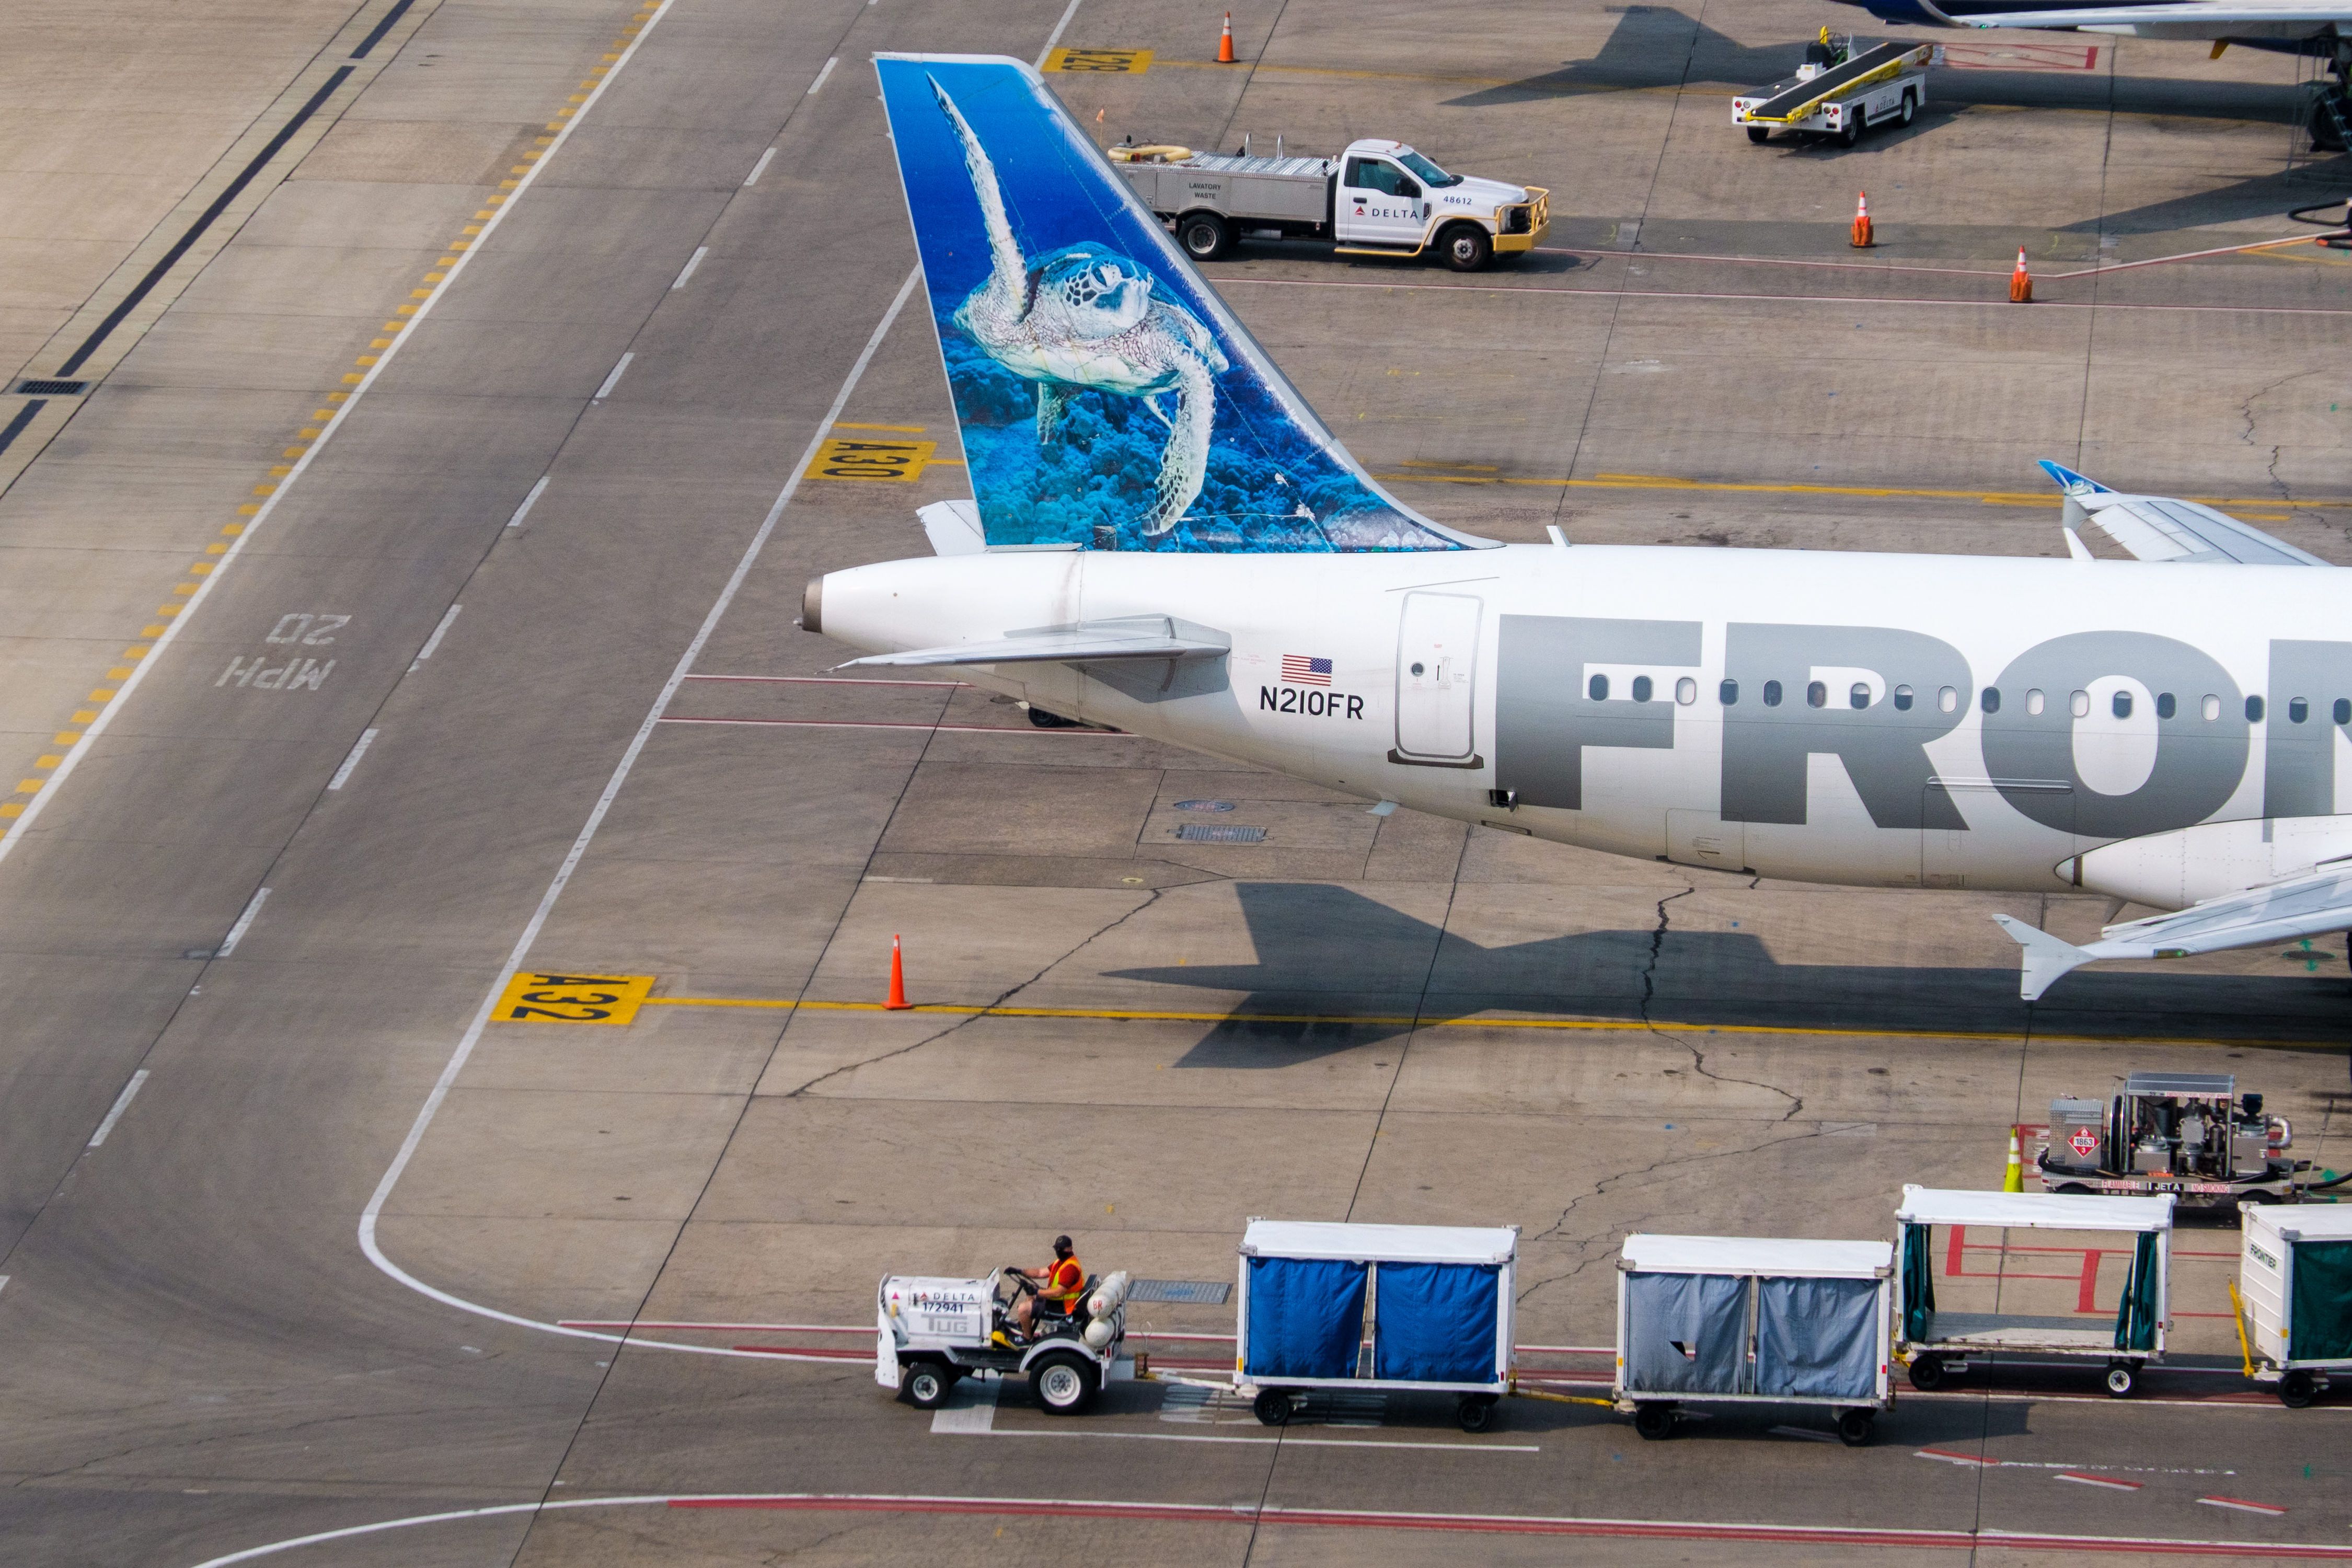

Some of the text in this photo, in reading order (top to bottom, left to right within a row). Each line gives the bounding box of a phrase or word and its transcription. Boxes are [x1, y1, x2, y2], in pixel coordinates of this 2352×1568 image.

[1061, 49, 1137, 72] A28
[1880, 97, 1895, 110] DELTA
[1443, 195, 1472, 205] 48612
[1371, 208, 1418, 219] DELTA
[822, 442, 917, 478] A30
[266, 613, 352, 644] 20
[213, 656, 337, 690] MPH
[1260, 686, 1364, 720] N210FR
[510, 974, 629, 1020] A32
[2103, 1180, 2139, 1190] FLAMMABLE
[2203, 1184, 2229, 1193] SMOKING
[2250, 1244, 2276, 1270] FRONTIER
[933, 1292, 975, 1301] DELTA
[923, 1302, 963, 1312] 172941
[921, 1313, 968, 1333] TUG
